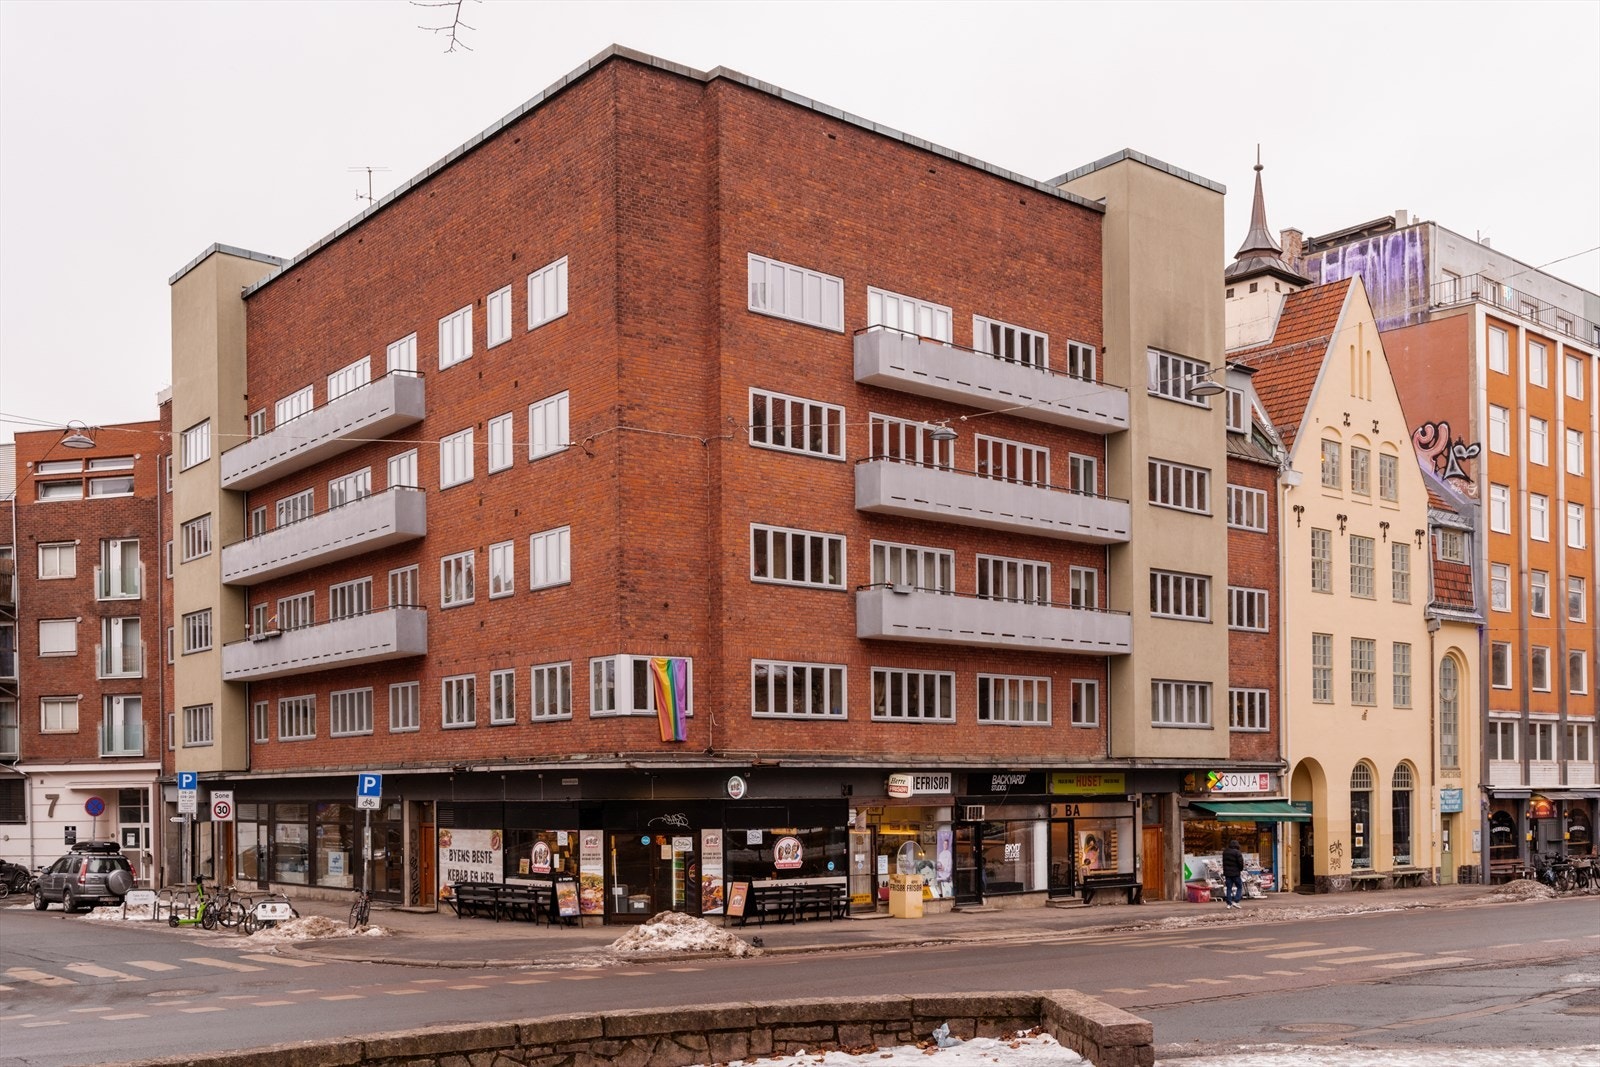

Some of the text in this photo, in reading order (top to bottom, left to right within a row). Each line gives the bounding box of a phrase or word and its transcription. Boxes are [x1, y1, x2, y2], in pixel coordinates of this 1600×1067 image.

[182, 774, 193, 787] P
[363, 776, 376, 794] P
[890, 777, 906, 785] Herre
[1076, 775, 1103, 787] HUSET
[1224, 775, 1258, 787] SONJA
[45, 794, 60, 818] 7
[217, 805, 228, 815] 30
[1065, 804, 1080, 817] BA
[448, 849, 493, 864] BYENS BESTE
[447, 869, 495, 883] KEBAB ER HER
